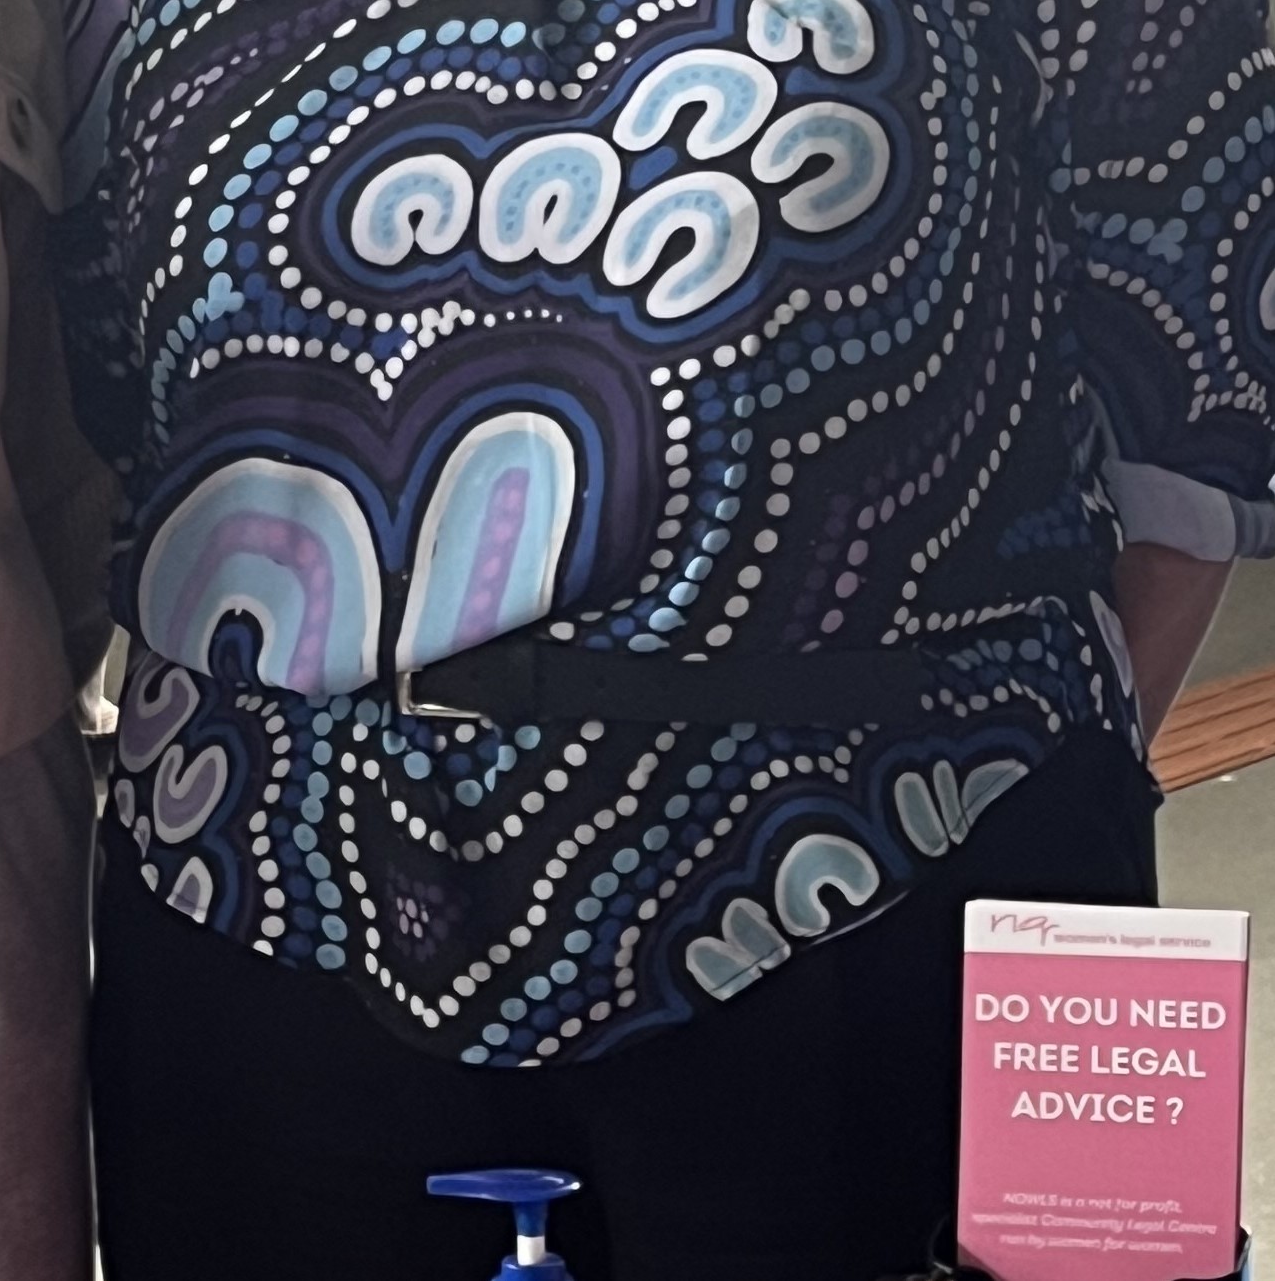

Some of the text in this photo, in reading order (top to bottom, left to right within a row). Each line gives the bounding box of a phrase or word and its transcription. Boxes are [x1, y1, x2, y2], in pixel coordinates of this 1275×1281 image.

[974, 993, 1226, 1030] DO YOU NEED
[993, 1041, 1206, 1078] FREE LEGAL
[1011, 1090, 1184, 1125] ADVICE ?
